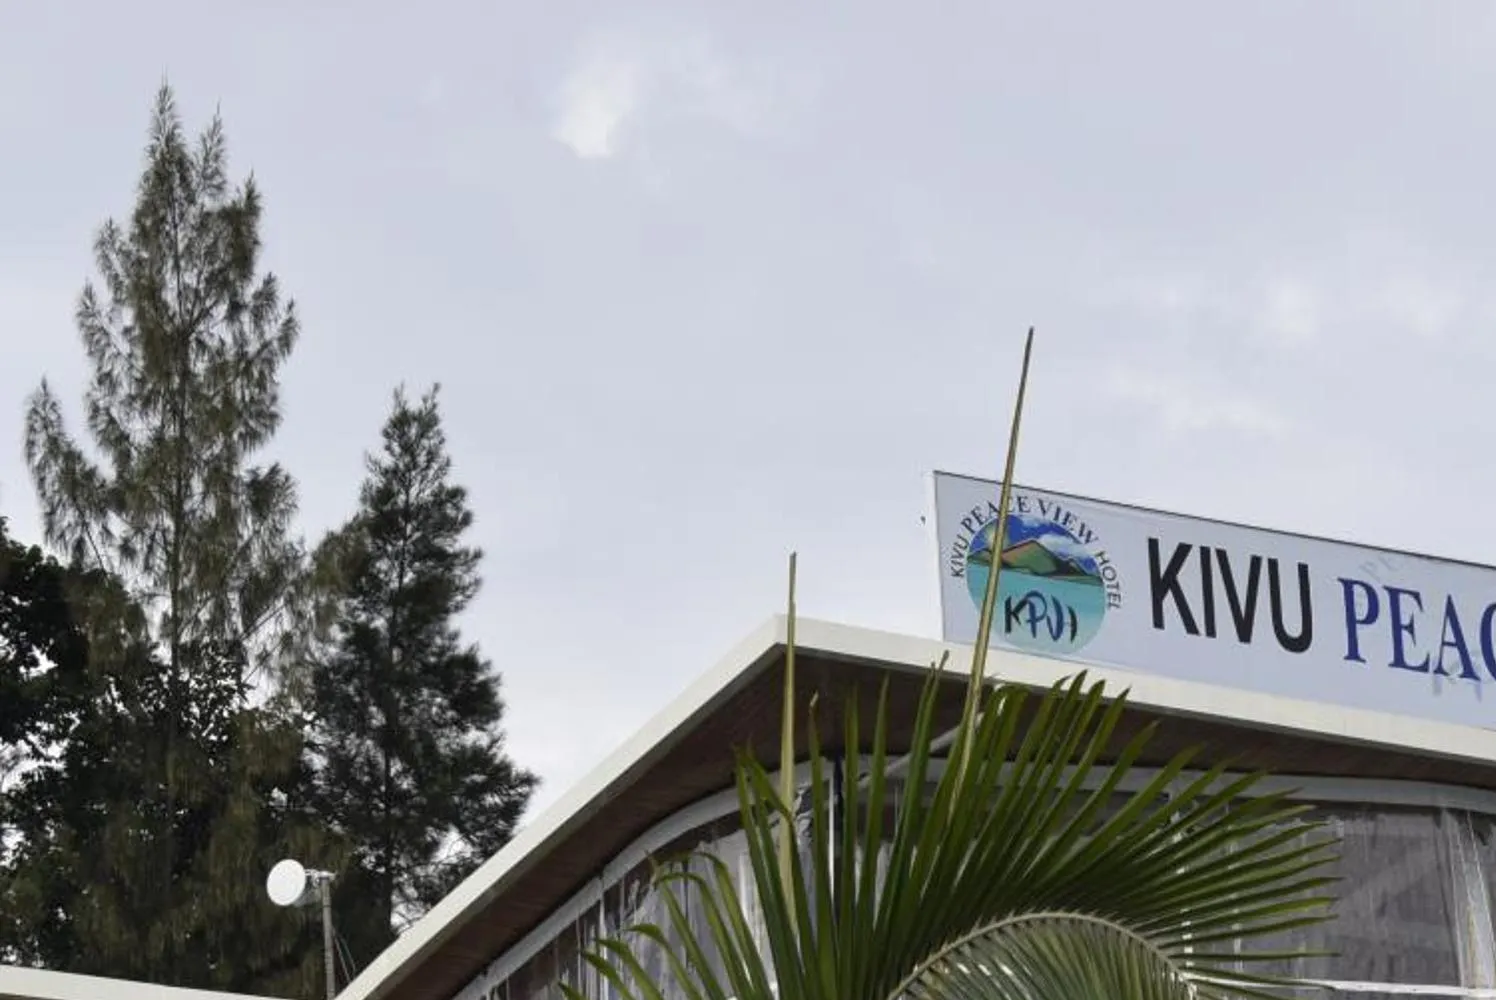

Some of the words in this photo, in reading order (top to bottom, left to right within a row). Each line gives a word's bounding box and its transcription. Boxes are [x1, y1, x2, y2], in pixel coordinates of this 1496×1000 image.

[951, 534, 972, 578] KIVU
[1037, 498, 1099, 544] VIEW
[1096, 550, 1122, 609] HOTEL
[1147, 537, 1313, 653] KIVU
